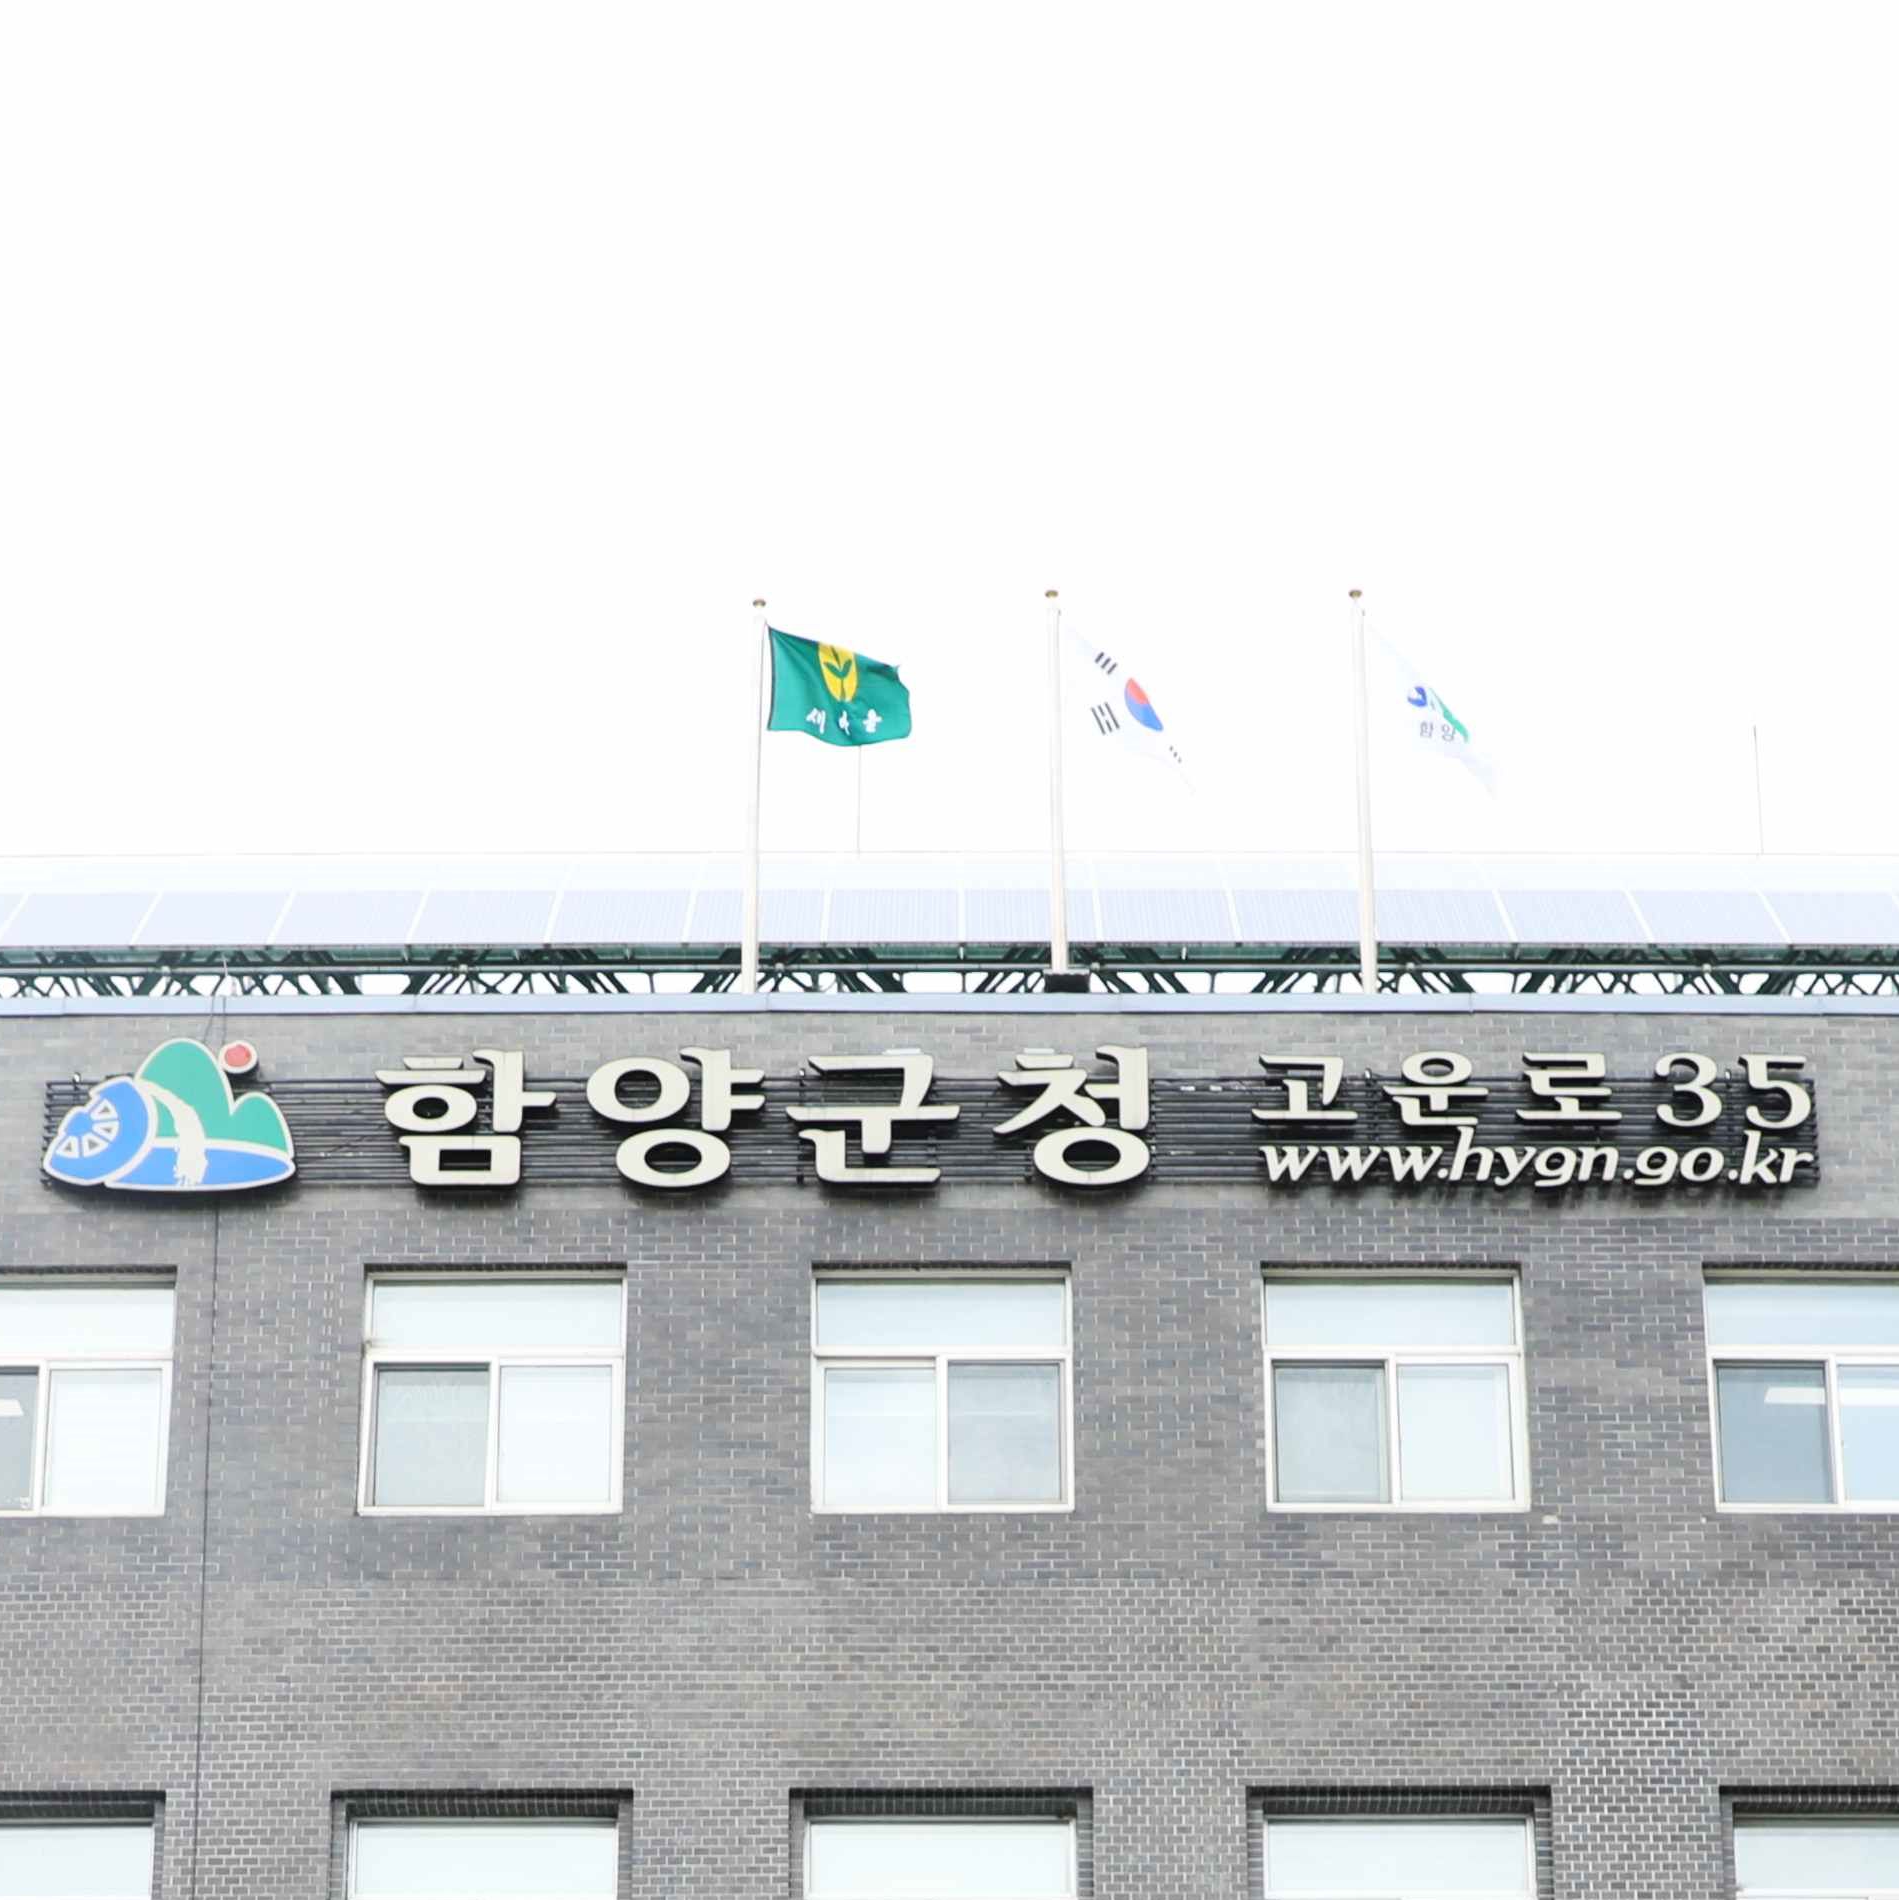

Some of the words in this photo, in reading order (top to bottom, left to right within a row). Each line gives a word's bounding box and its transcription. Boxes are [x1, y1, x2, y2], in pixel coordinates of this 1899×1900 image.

[375, 1045, 1152, 1188] 함양군청
[1251, 1051, 1623, 1128] 고운로
[1654, 1051, 1815, 1131] 35
[1259, 1126, 1816, 1189] www.hygn.go.kr
